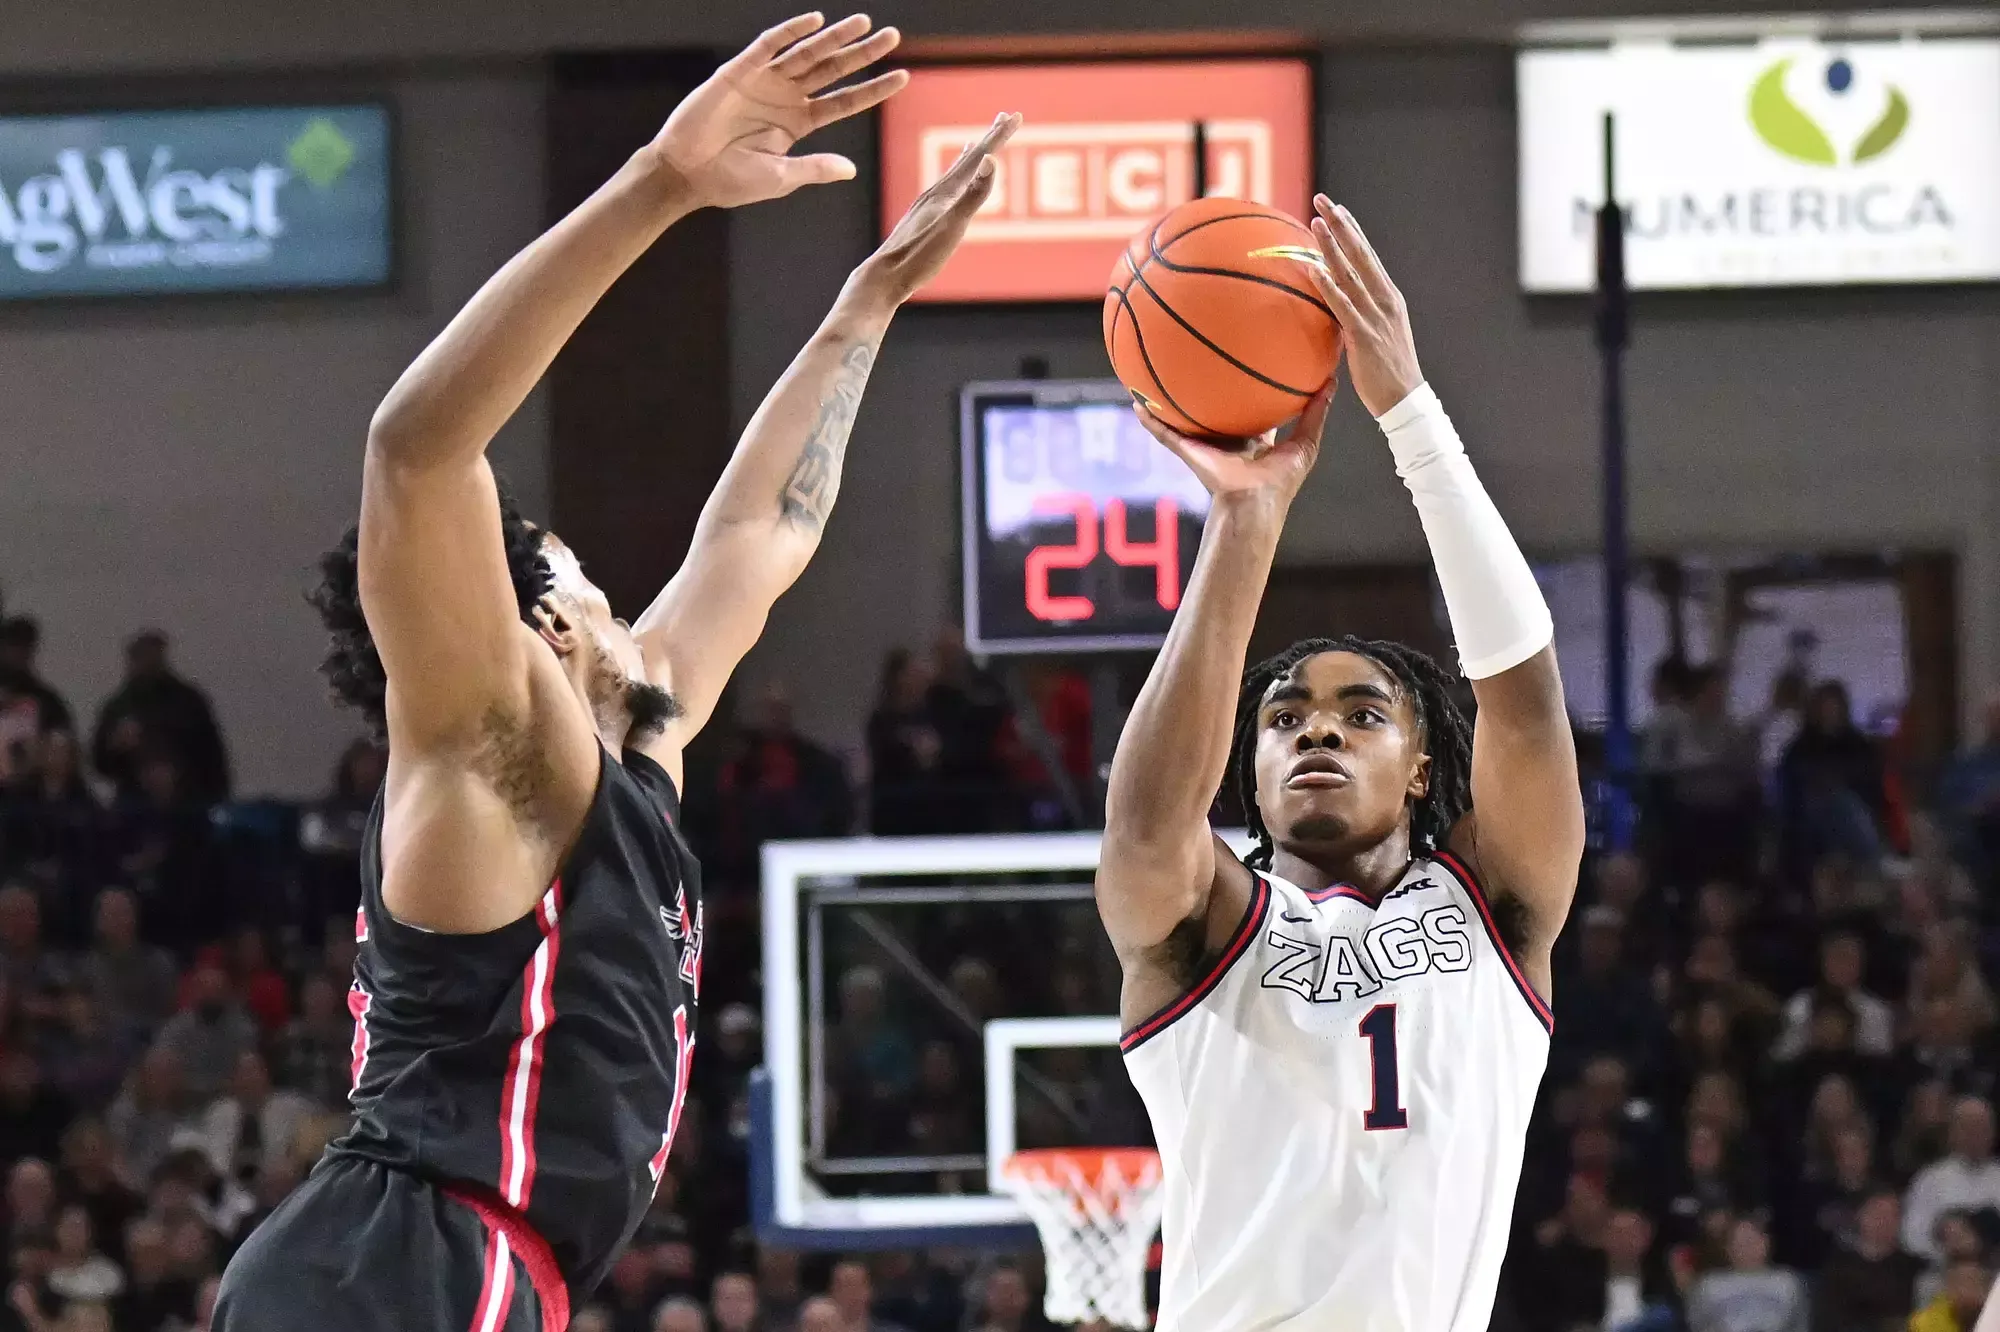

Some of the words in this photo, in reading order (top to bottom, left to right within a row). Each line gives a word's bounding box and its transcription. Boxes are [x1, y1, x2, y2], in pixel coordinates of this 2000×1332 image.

[1025, 494, 1179, 621] 24
[1261, 905, 1472, 1003] ZAGS
[1359, 1003, 1408, 1131] 1
